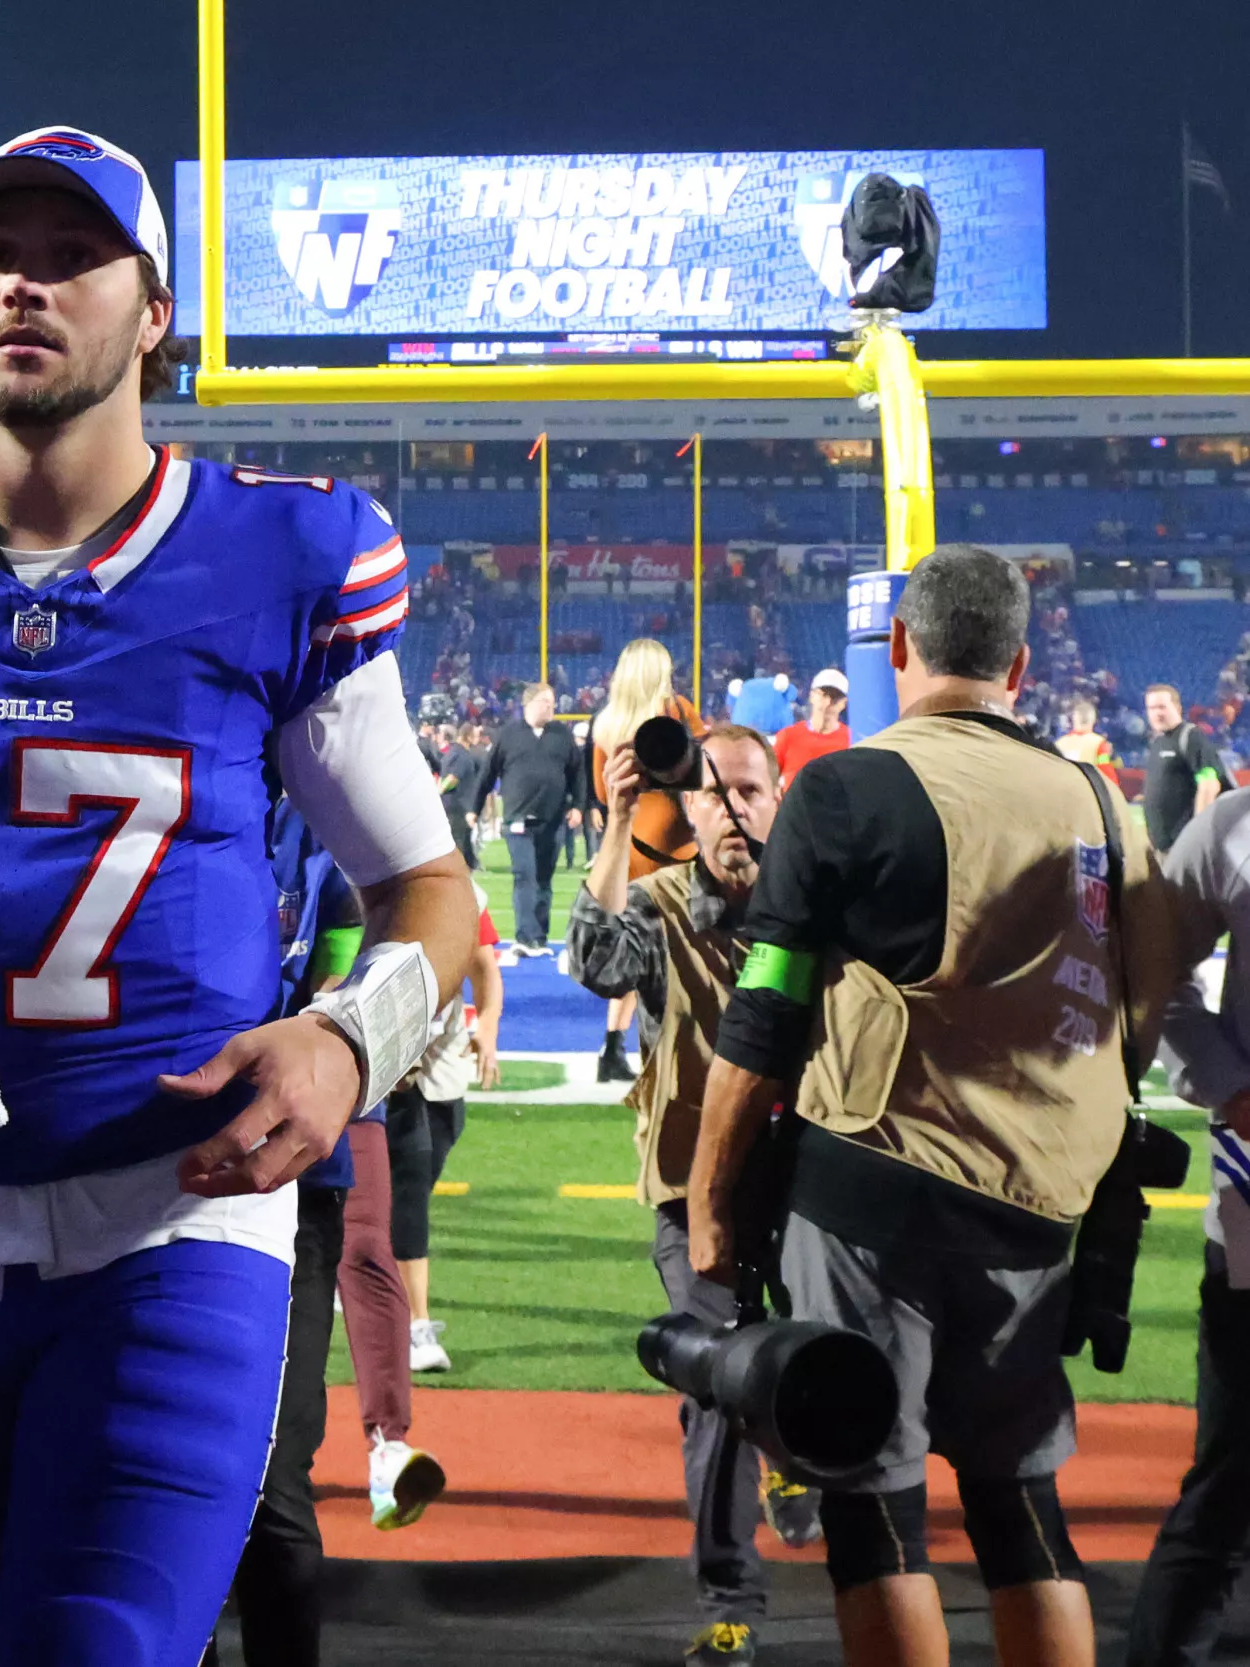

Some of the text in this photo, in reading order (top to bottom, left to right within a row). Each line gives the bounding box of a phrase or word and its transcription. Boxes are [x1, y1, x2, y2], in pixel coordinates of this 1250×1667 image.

[459, 168, 748, 219] THURSDAY
[271, 209, 402, 309] TNF
[510, 217, 685, 268] NIGHT
[453, 268, 734, 318] FOOTBALL
[19, 627, 51, 649] NFL
